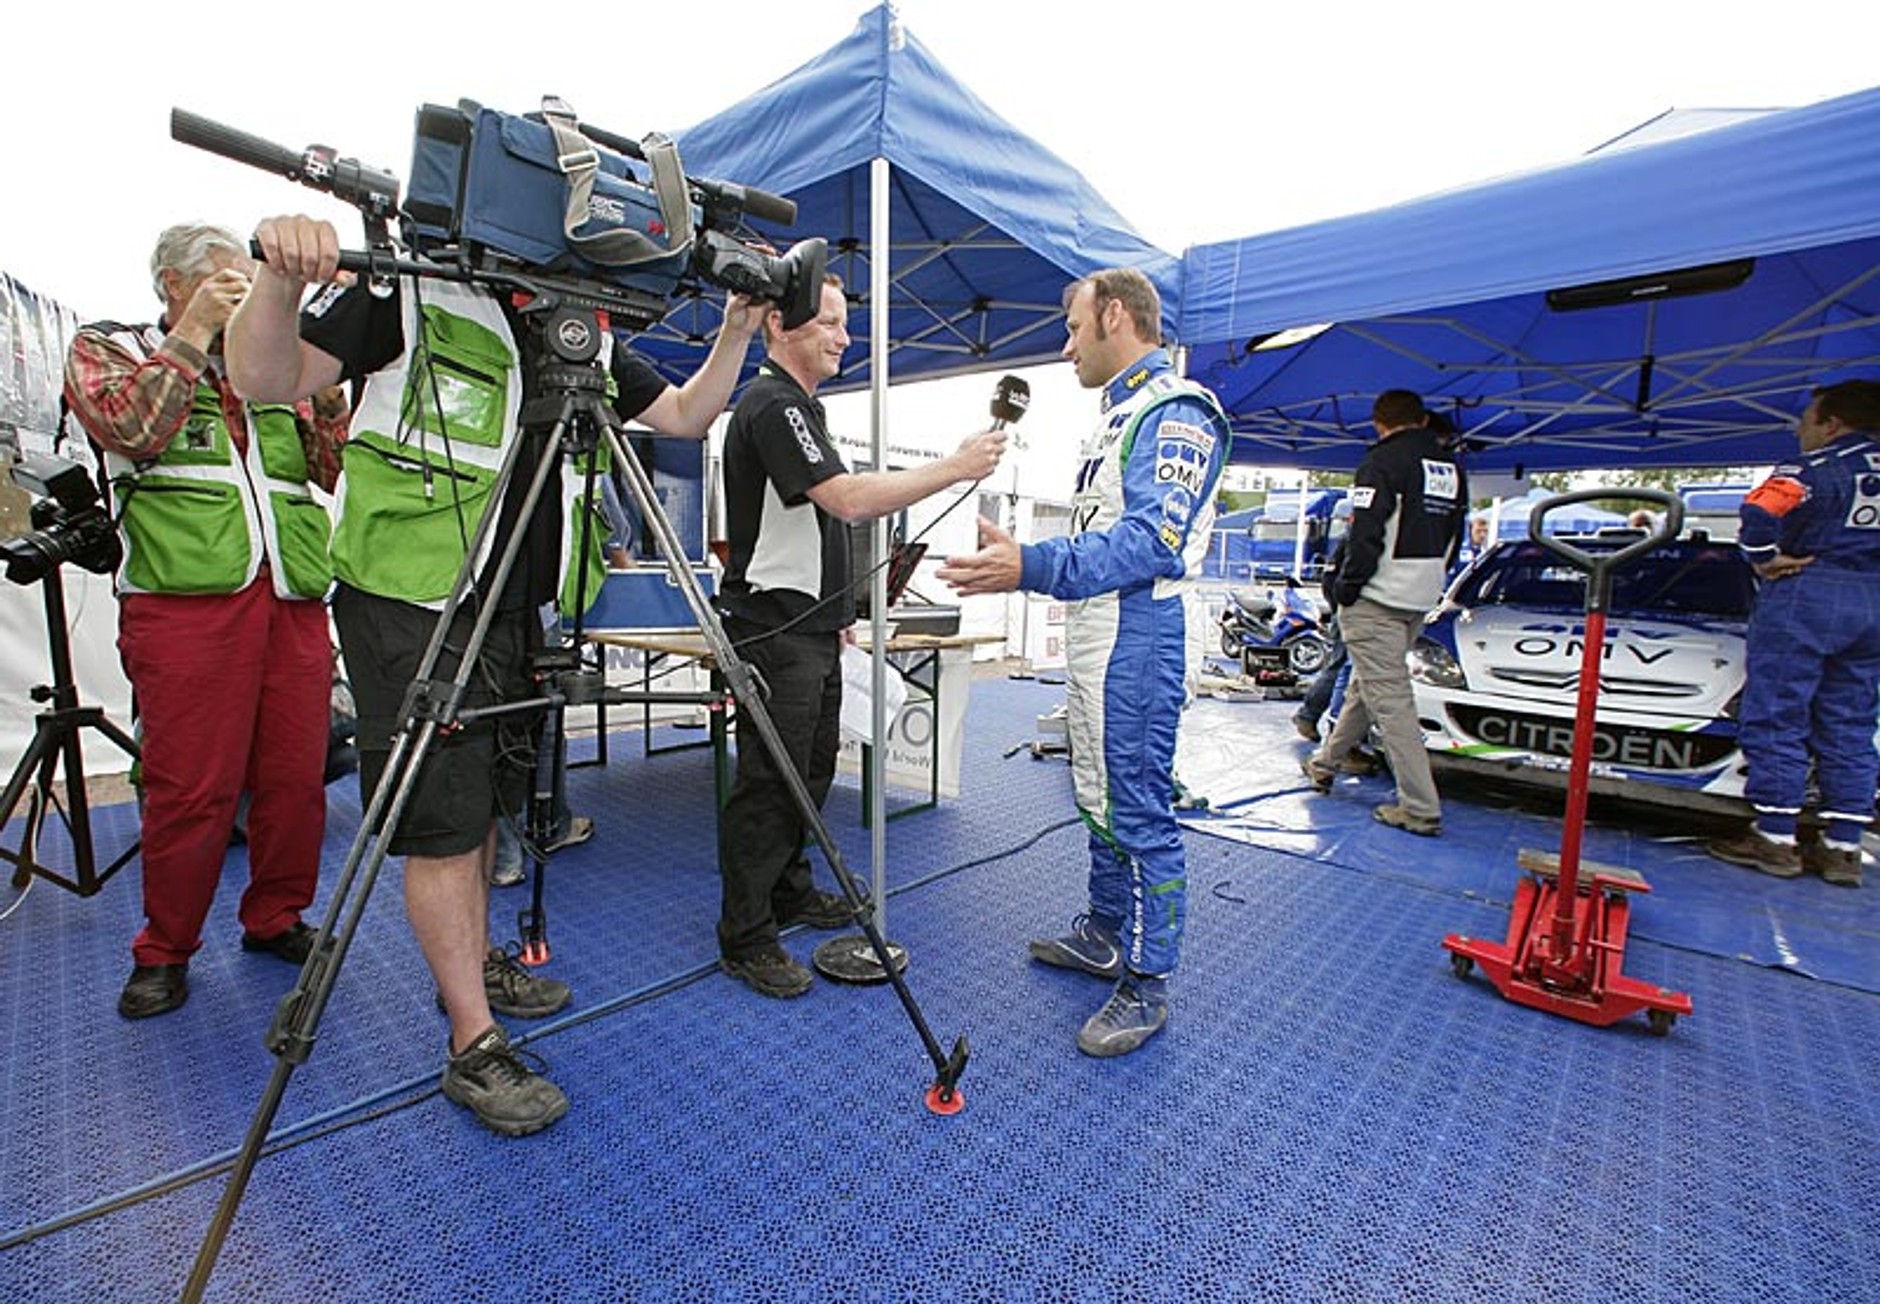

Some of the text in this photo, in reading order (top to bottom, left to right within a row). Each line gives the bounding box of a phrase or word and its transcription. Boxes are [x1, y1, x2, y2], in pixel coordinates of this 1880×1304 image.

[1158, 463, 1202, 492] OMV
[1514, 638, 1673, 665] OMV
[1477, 716, 1692, 769] CITROËN
